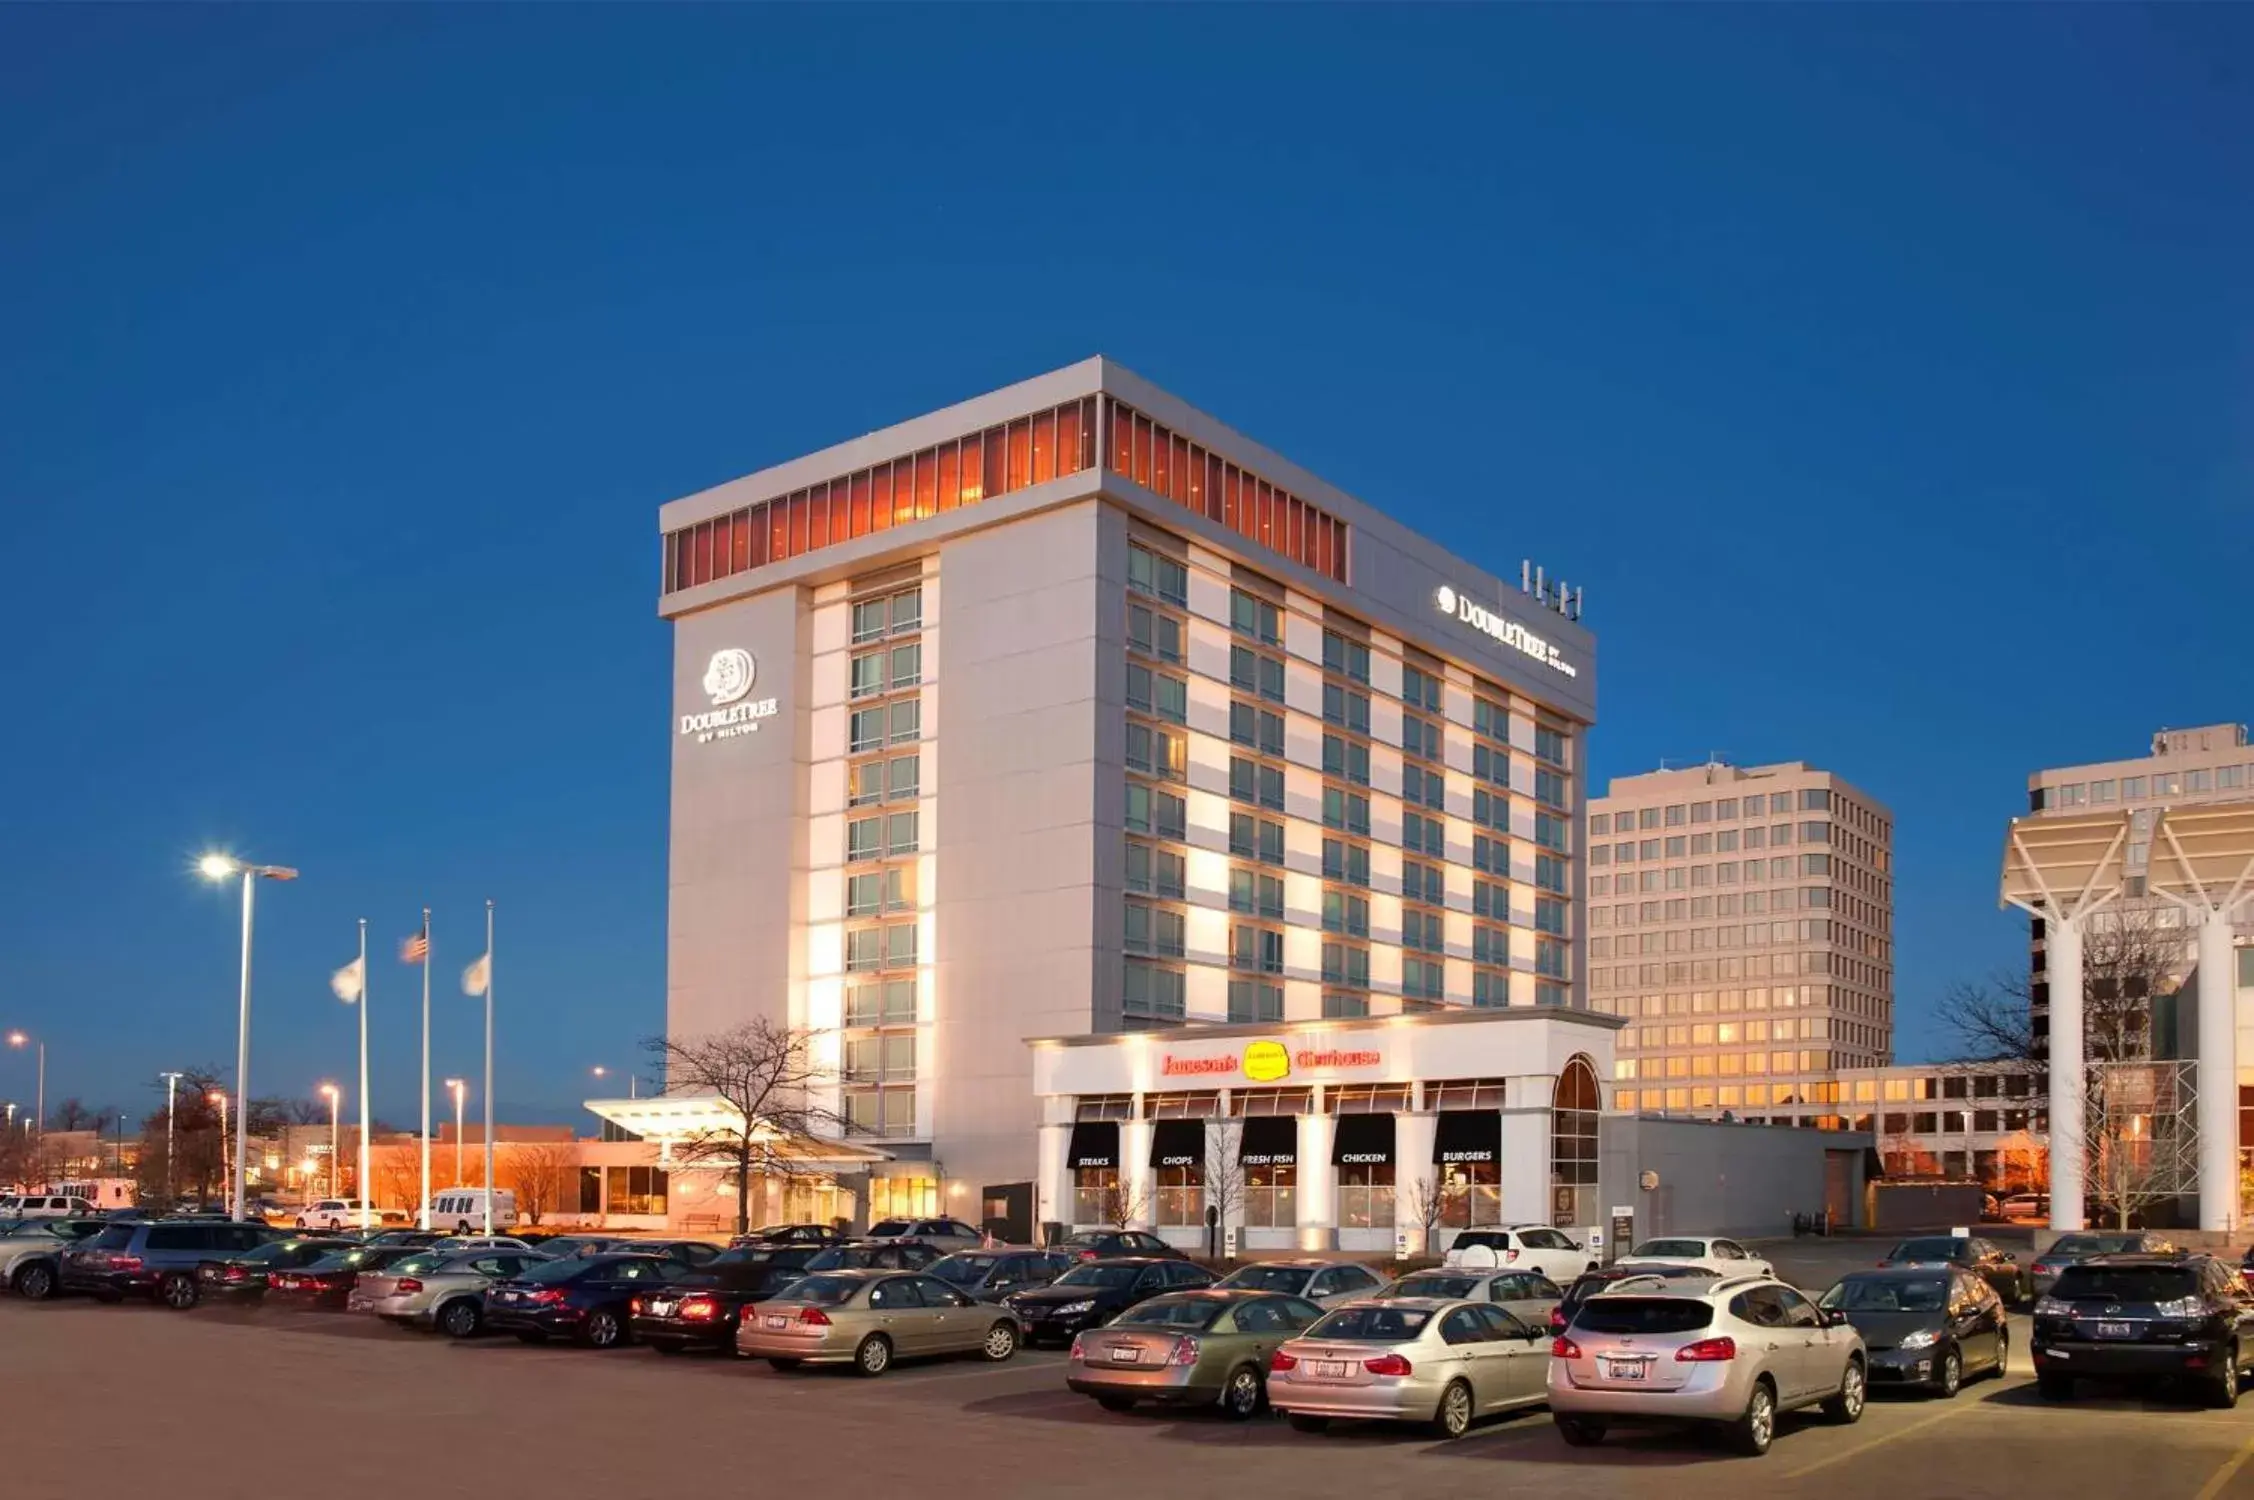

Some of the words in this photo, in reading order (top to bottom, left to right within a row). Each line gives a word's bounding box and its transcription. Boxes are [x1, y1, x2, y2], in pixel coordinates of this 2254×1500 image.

[1458, 595, 1548, 662] DOUBLETREE
[680, 698, 778, 734] DOUBLETREE
[697, 733, 714, 743] BY
[718, 723, 759, 739] HILTON
[1078, 1156, 1109, 1166] STEAKS
[1162, 1155, 1193, 1166] CHOPS
[1242, 1154, 1270, 1165] FRESH
[1272, 1154, 1294, 1164] FISH
[1342, 1153, 1386, 1164] CHICKEN
[1442, 1150, 1492, 1162] BURGERS
